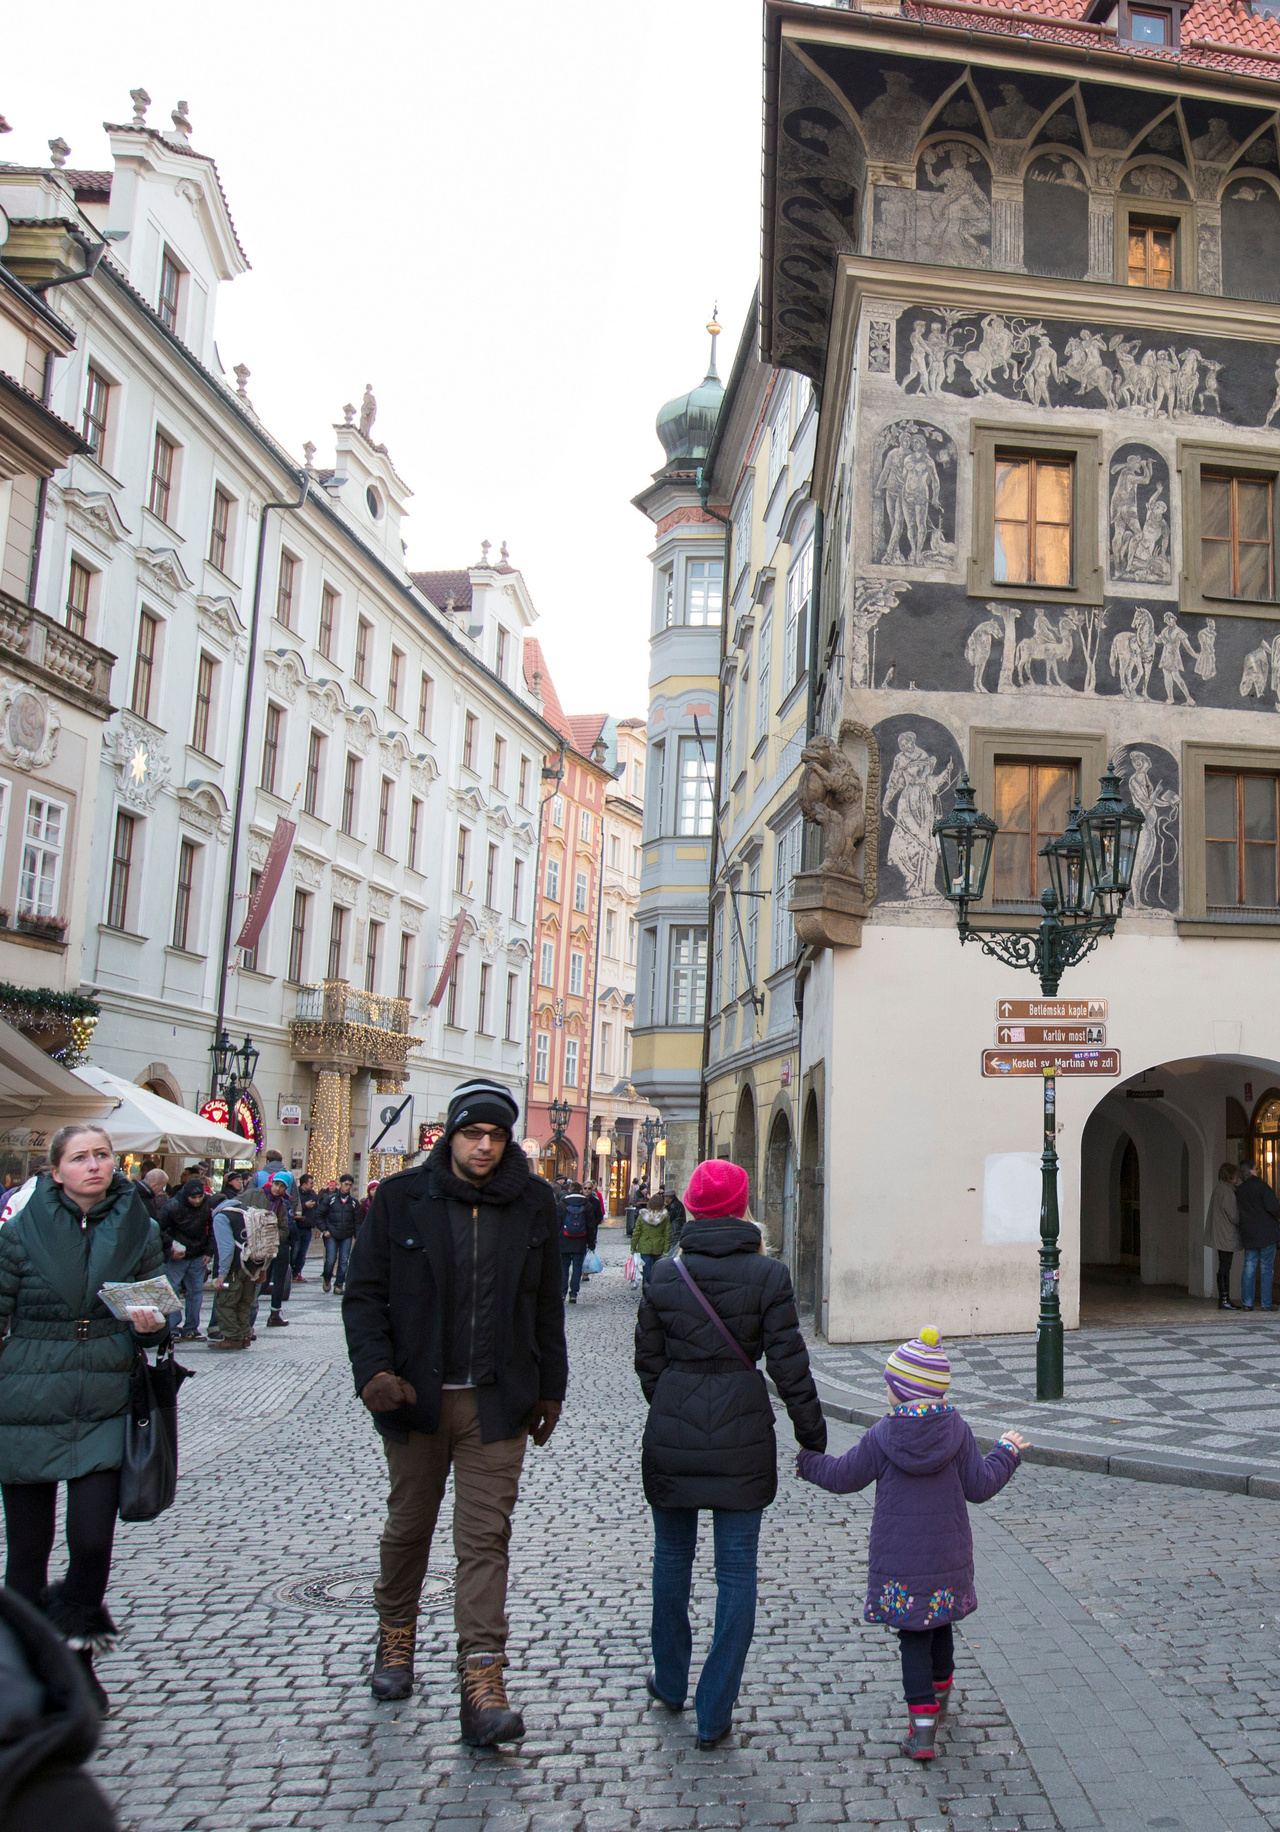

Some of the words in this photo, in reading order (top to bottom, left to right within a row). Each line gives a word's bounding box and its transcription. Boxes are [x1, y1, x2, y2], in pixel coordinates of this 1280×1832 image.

[1029, 1004, 1066, 1016] Betlémská
[1068, 1004, 1087, 1019] kaple
[1043, 1030, 1066, 1042] Karlův
[1068, 1030, 1086, 1042] most
[1012, 1058, 1037, 1068] Kostel
[1055, 1058, 1085, 1068] Martina
[1088, 1059, 1098, 1068] ve
[1101, 1057, 1114, 1068] zdi
